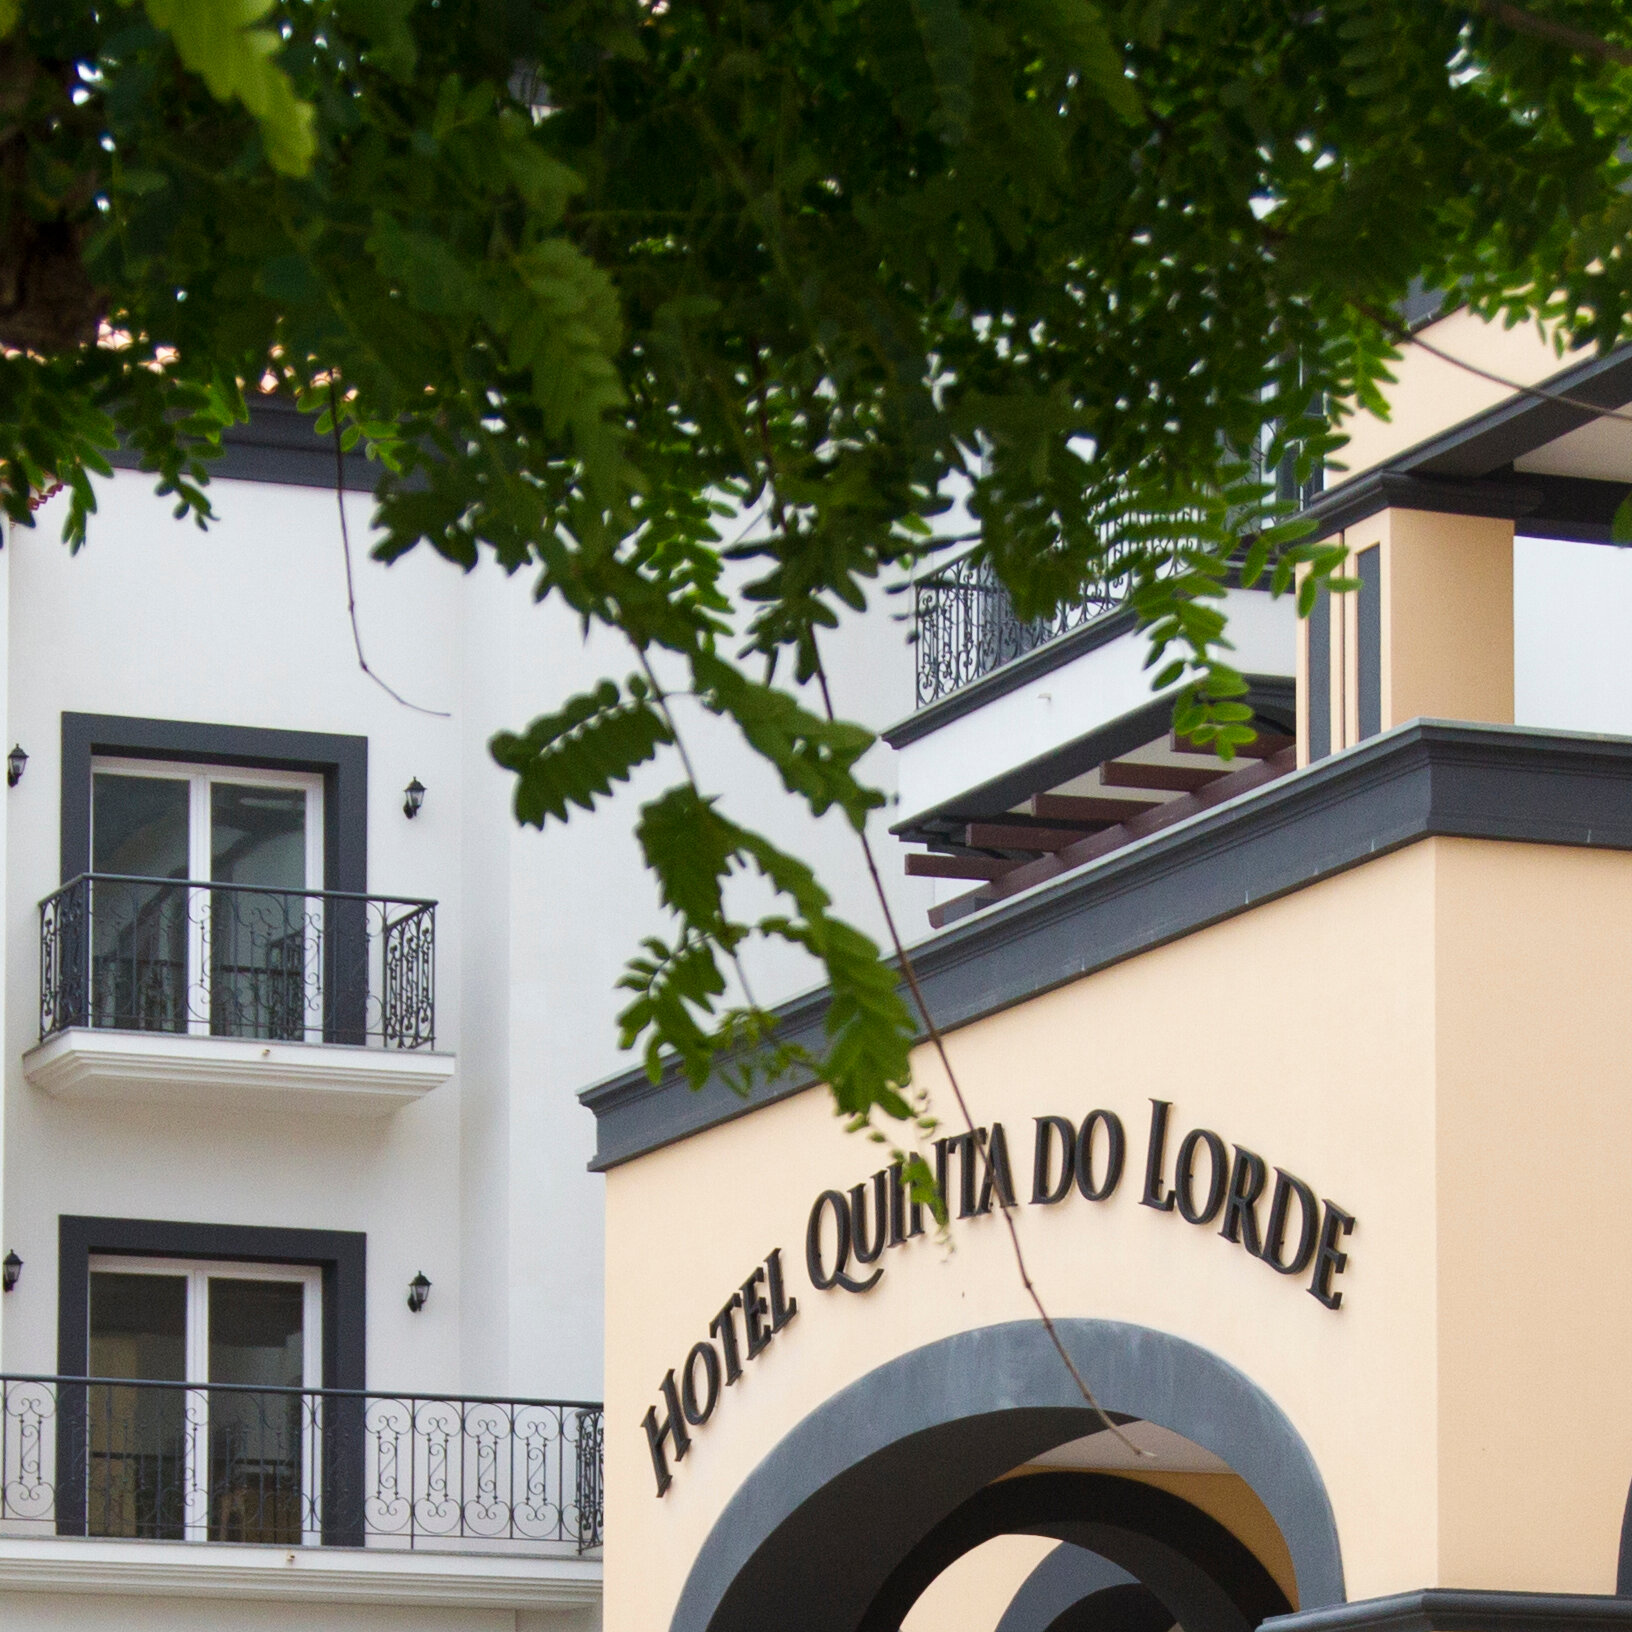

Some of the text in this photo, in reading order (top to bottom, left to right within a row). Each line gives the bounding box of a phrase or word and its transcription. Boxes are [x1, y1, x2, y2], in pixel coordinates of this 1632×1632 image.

[640, 1248, 797, 1498] HOTEL
[1030, 1109, 1125, 1205] DO
[1139, 1098, 1356, 1310] LORDE
